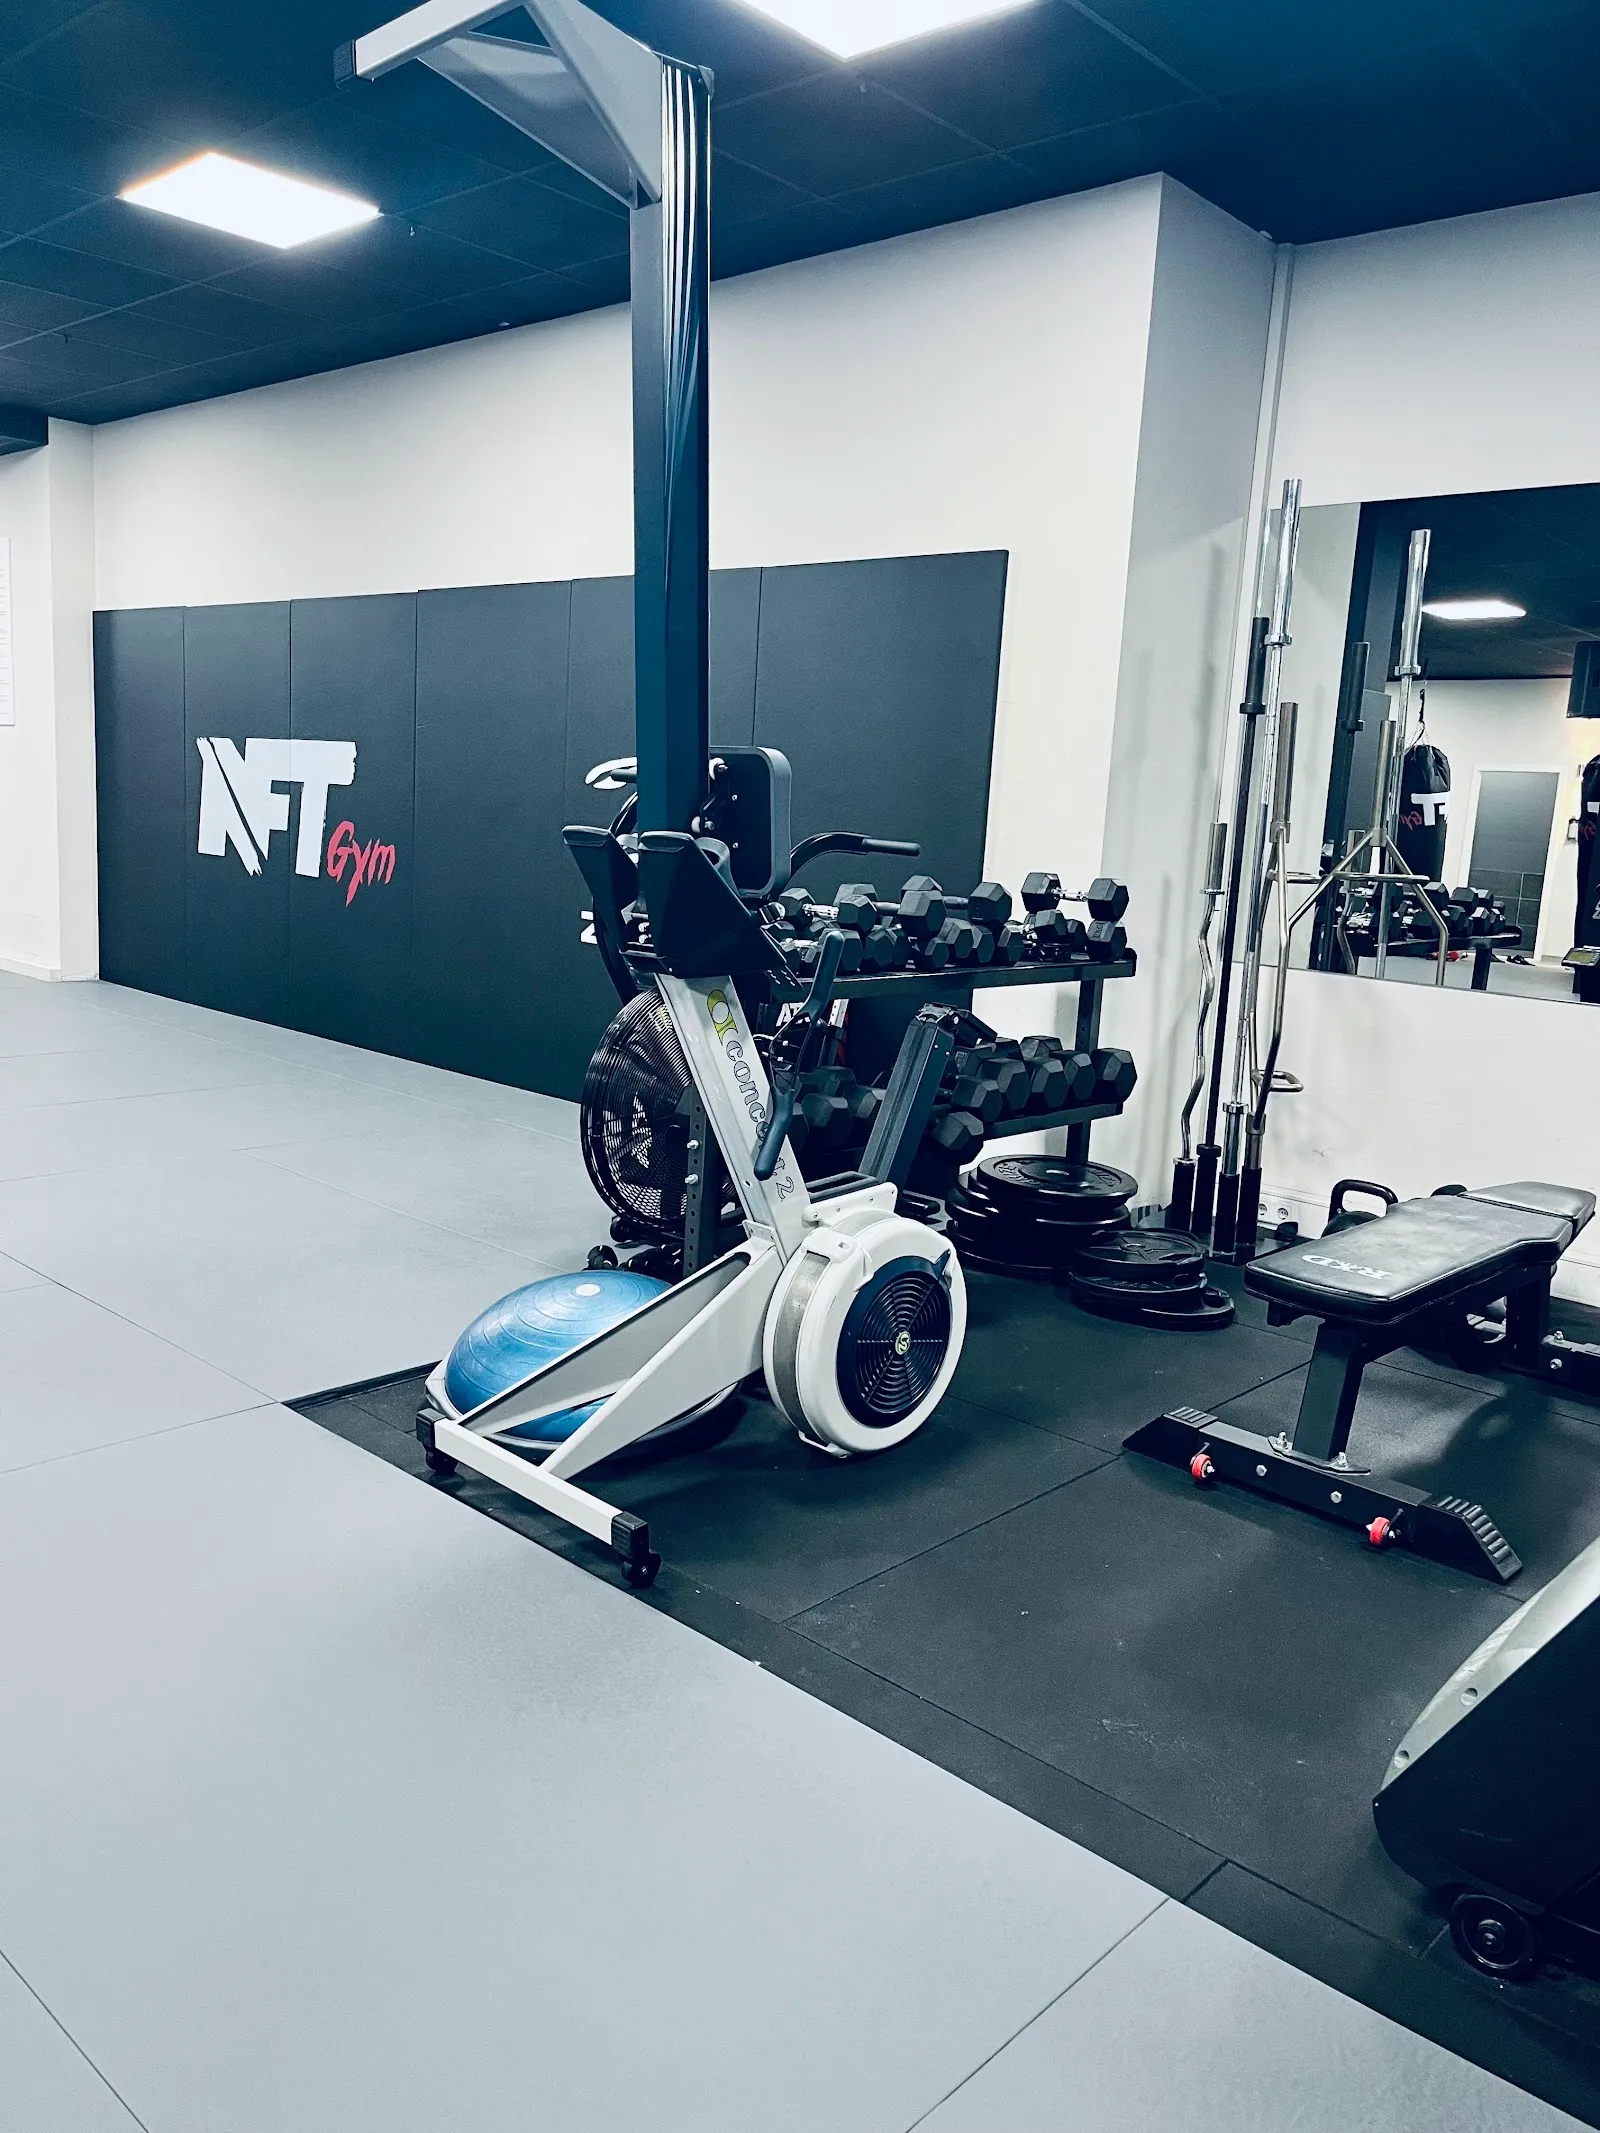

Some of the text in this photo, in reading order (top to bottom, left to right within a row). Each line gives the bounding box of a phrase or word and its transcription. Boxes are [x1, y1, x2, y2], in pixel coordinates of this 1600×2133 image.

[195, 736, 396, 908] NFT Gym
[775, 1176, 794, 1200] 2
